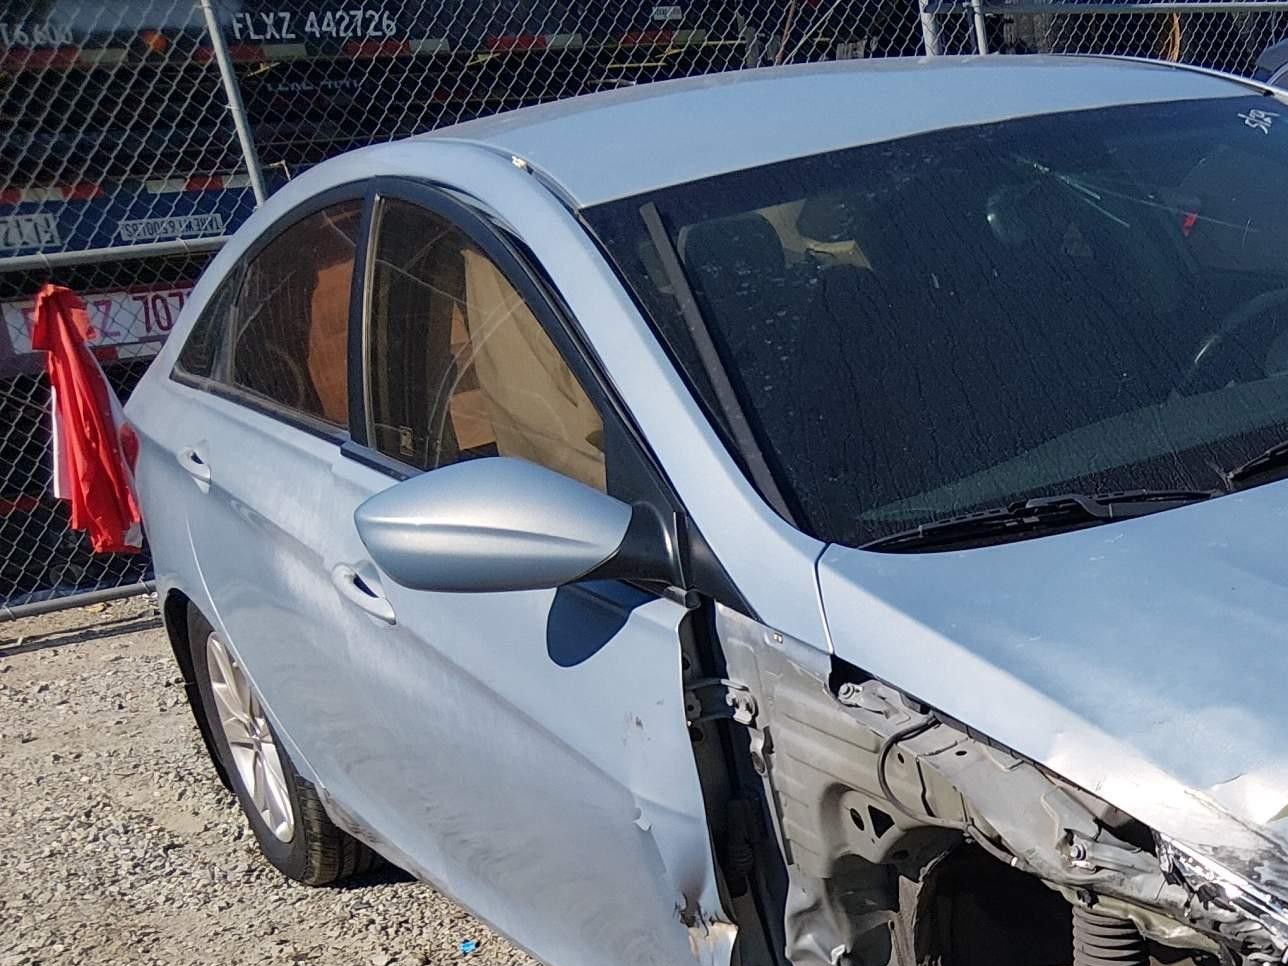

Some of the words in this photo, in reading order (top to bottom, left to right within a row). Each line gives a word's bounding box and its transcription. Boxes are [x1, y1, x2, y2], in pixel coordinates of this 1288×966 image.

[231, 11, 296, 40] FLXZ
[304, 9, 397, 38] 442726
[132, 290, 192, 334] 707
